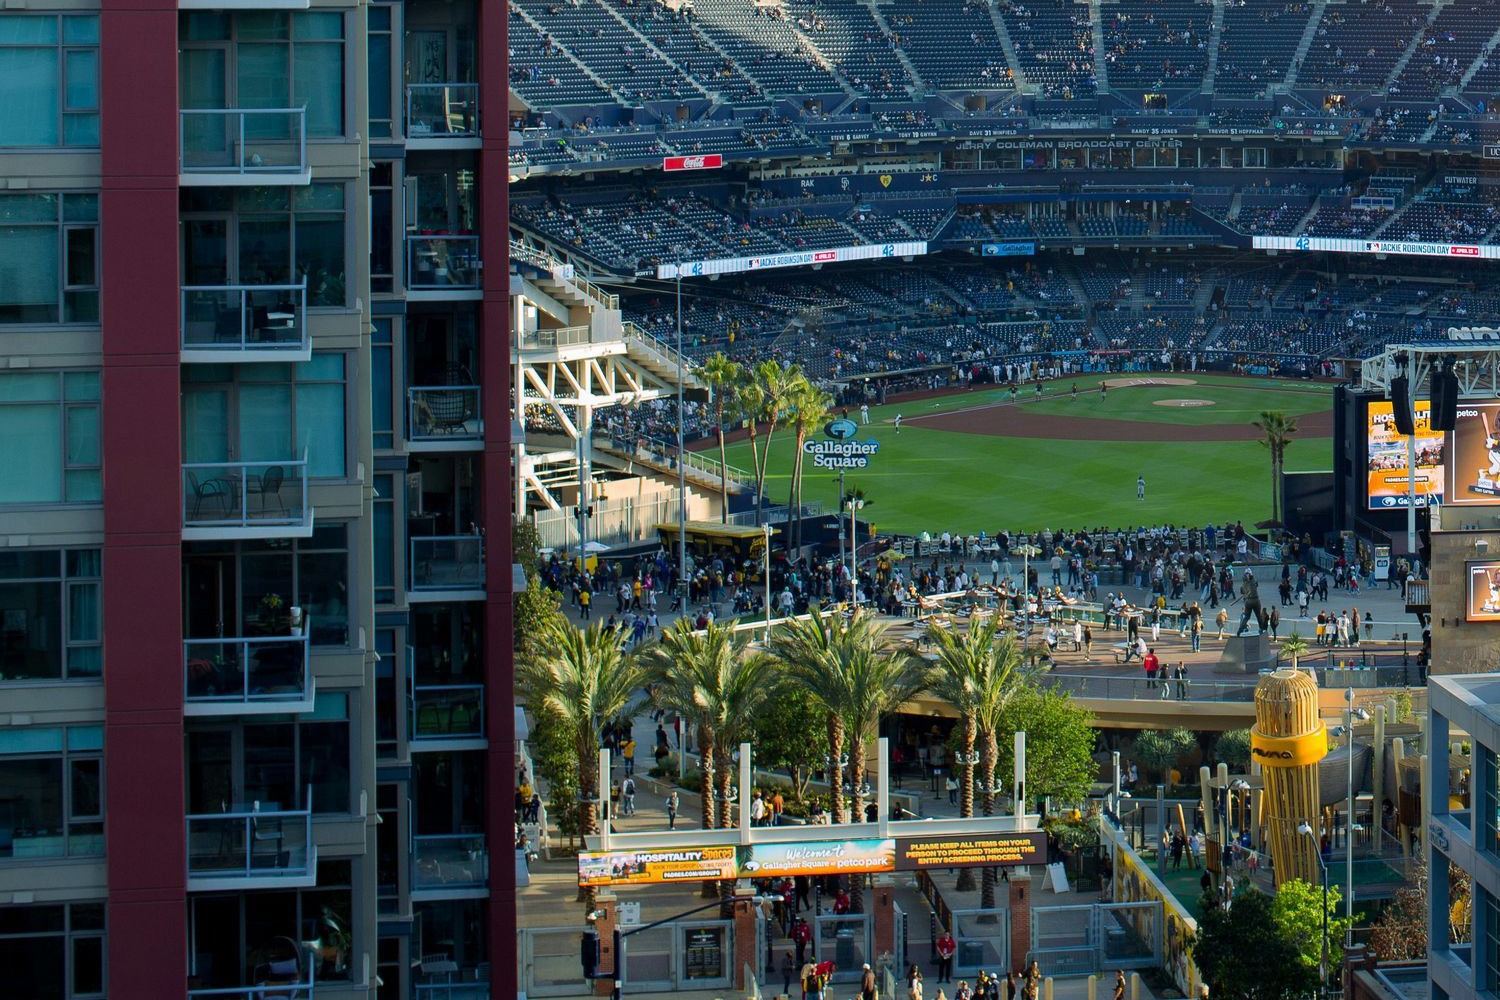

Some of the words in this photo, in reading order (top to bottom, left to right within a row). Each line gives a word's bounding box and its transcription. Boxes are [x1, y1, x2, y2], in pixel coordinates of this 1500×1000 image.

[956, 142, 992, 150] JERRY
[997, 141, 1053, 149] COLEMAN
[1058, 140, 1131, 148] BROADCAST
[1136, 140, 1183, 148] CENTER
[1490, 148, 1500, 156] UC
[1444, 176, 1477, 184] CUTWATER
[1296, 237, 1310, 250] 42
[1380, 243, 1401, 252] JACKIE
[1403, 244, 1436, 253] ROBINSON
[1437, 246, 1450, 254] DAY
[882, 245, 895, 256] 42
[760, 258, 776, 267] JACKIE
[777, 256, 803, 266] ROBINSON
[803, 254, 813, 263] DAY
[1456, 410, 1478, 418] petco
[803, 441, 877, 456] Gallagher
[814, 454, 867, 470] Square
[637, 850, 701, 863] HOSPITALITY
[786, 848, 831, 860] Welcome
[833, 844, 845, 856] to
[983, 847, 1020, 855] THROUGH
[762, 861, 800, 870] Gallagher
[837, 859, 864, 868] petco
[866, 857, 888, 867] park
[987, 854, 1023, 862] PROCESS.
[664, 870, 721, 878] PADRES.COM/GROUPS
